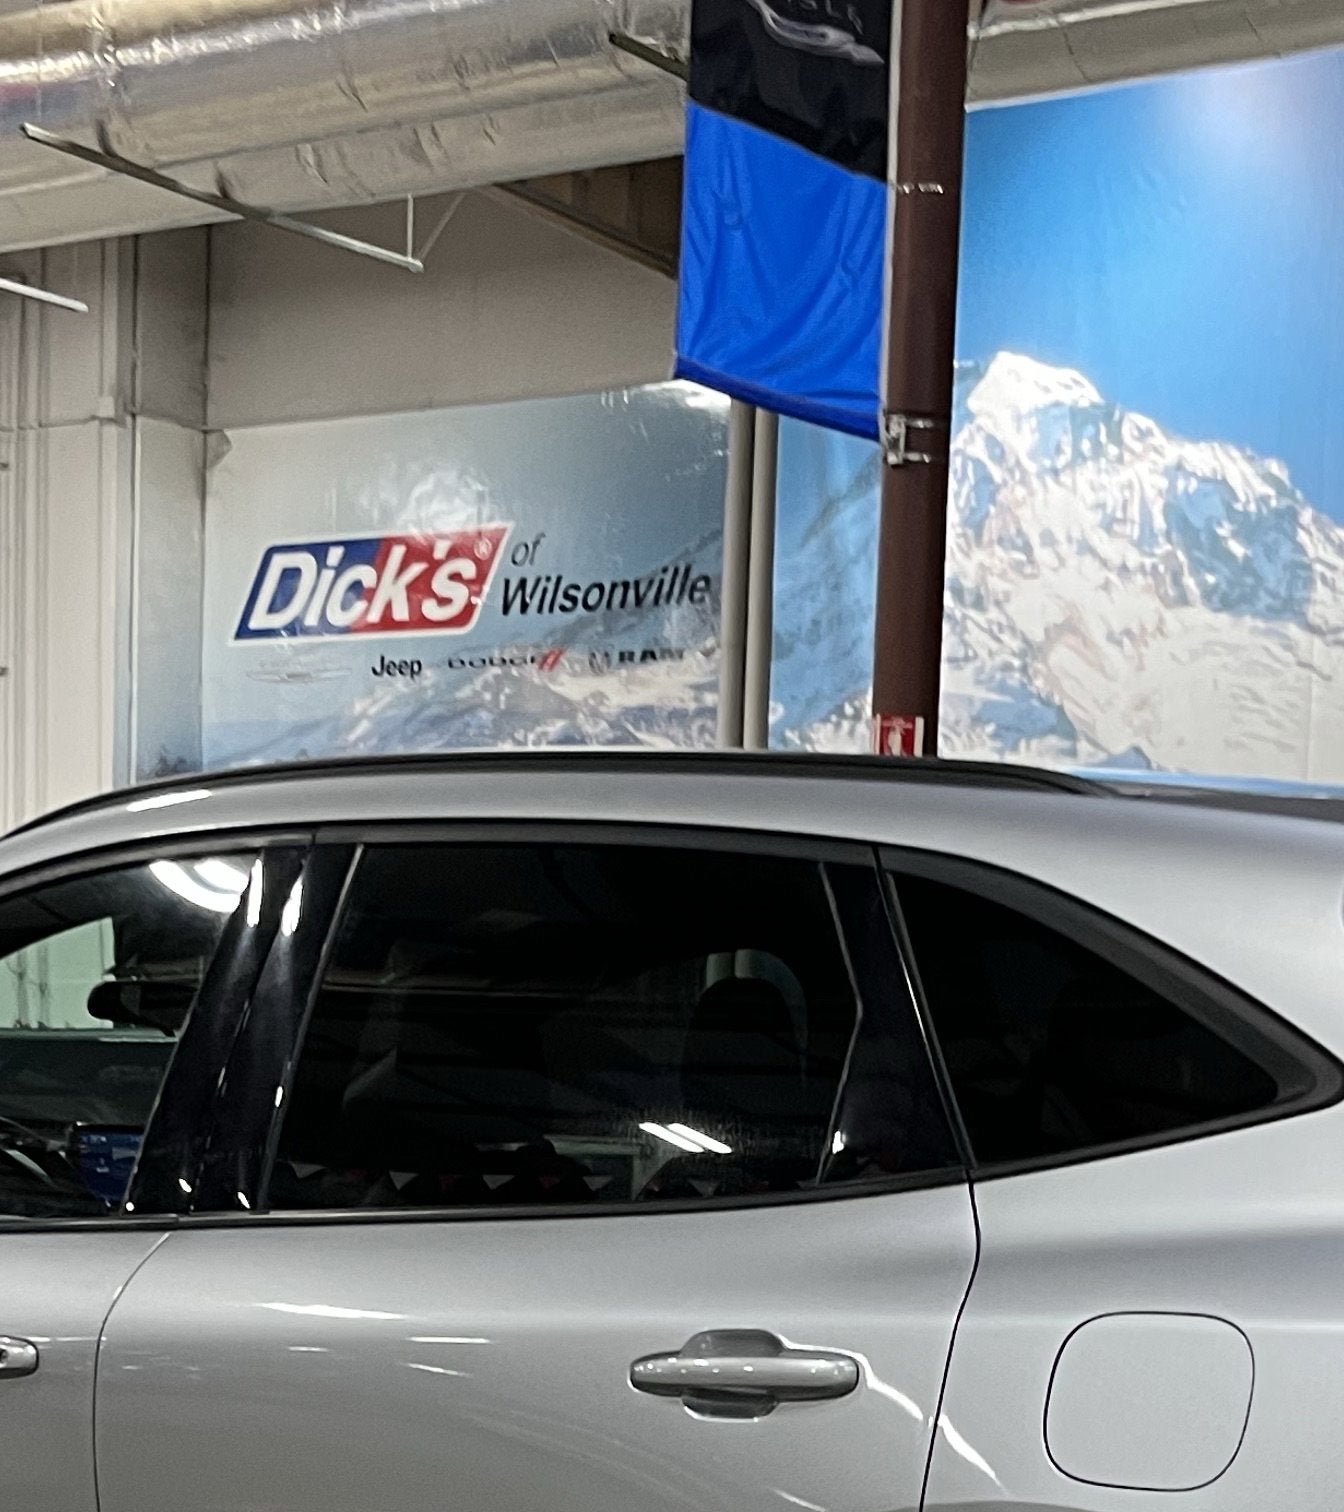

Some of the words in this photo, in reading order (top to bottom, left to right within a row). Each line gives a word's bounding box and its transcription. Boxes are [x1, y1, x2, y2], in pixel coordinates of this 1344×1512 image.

[248, 538, 477, 631] Dick's
[511, 532, 546, 567] of
[502, 564, 711, 616] Wilsonville
[372, 654, 423, 681] Jeep
